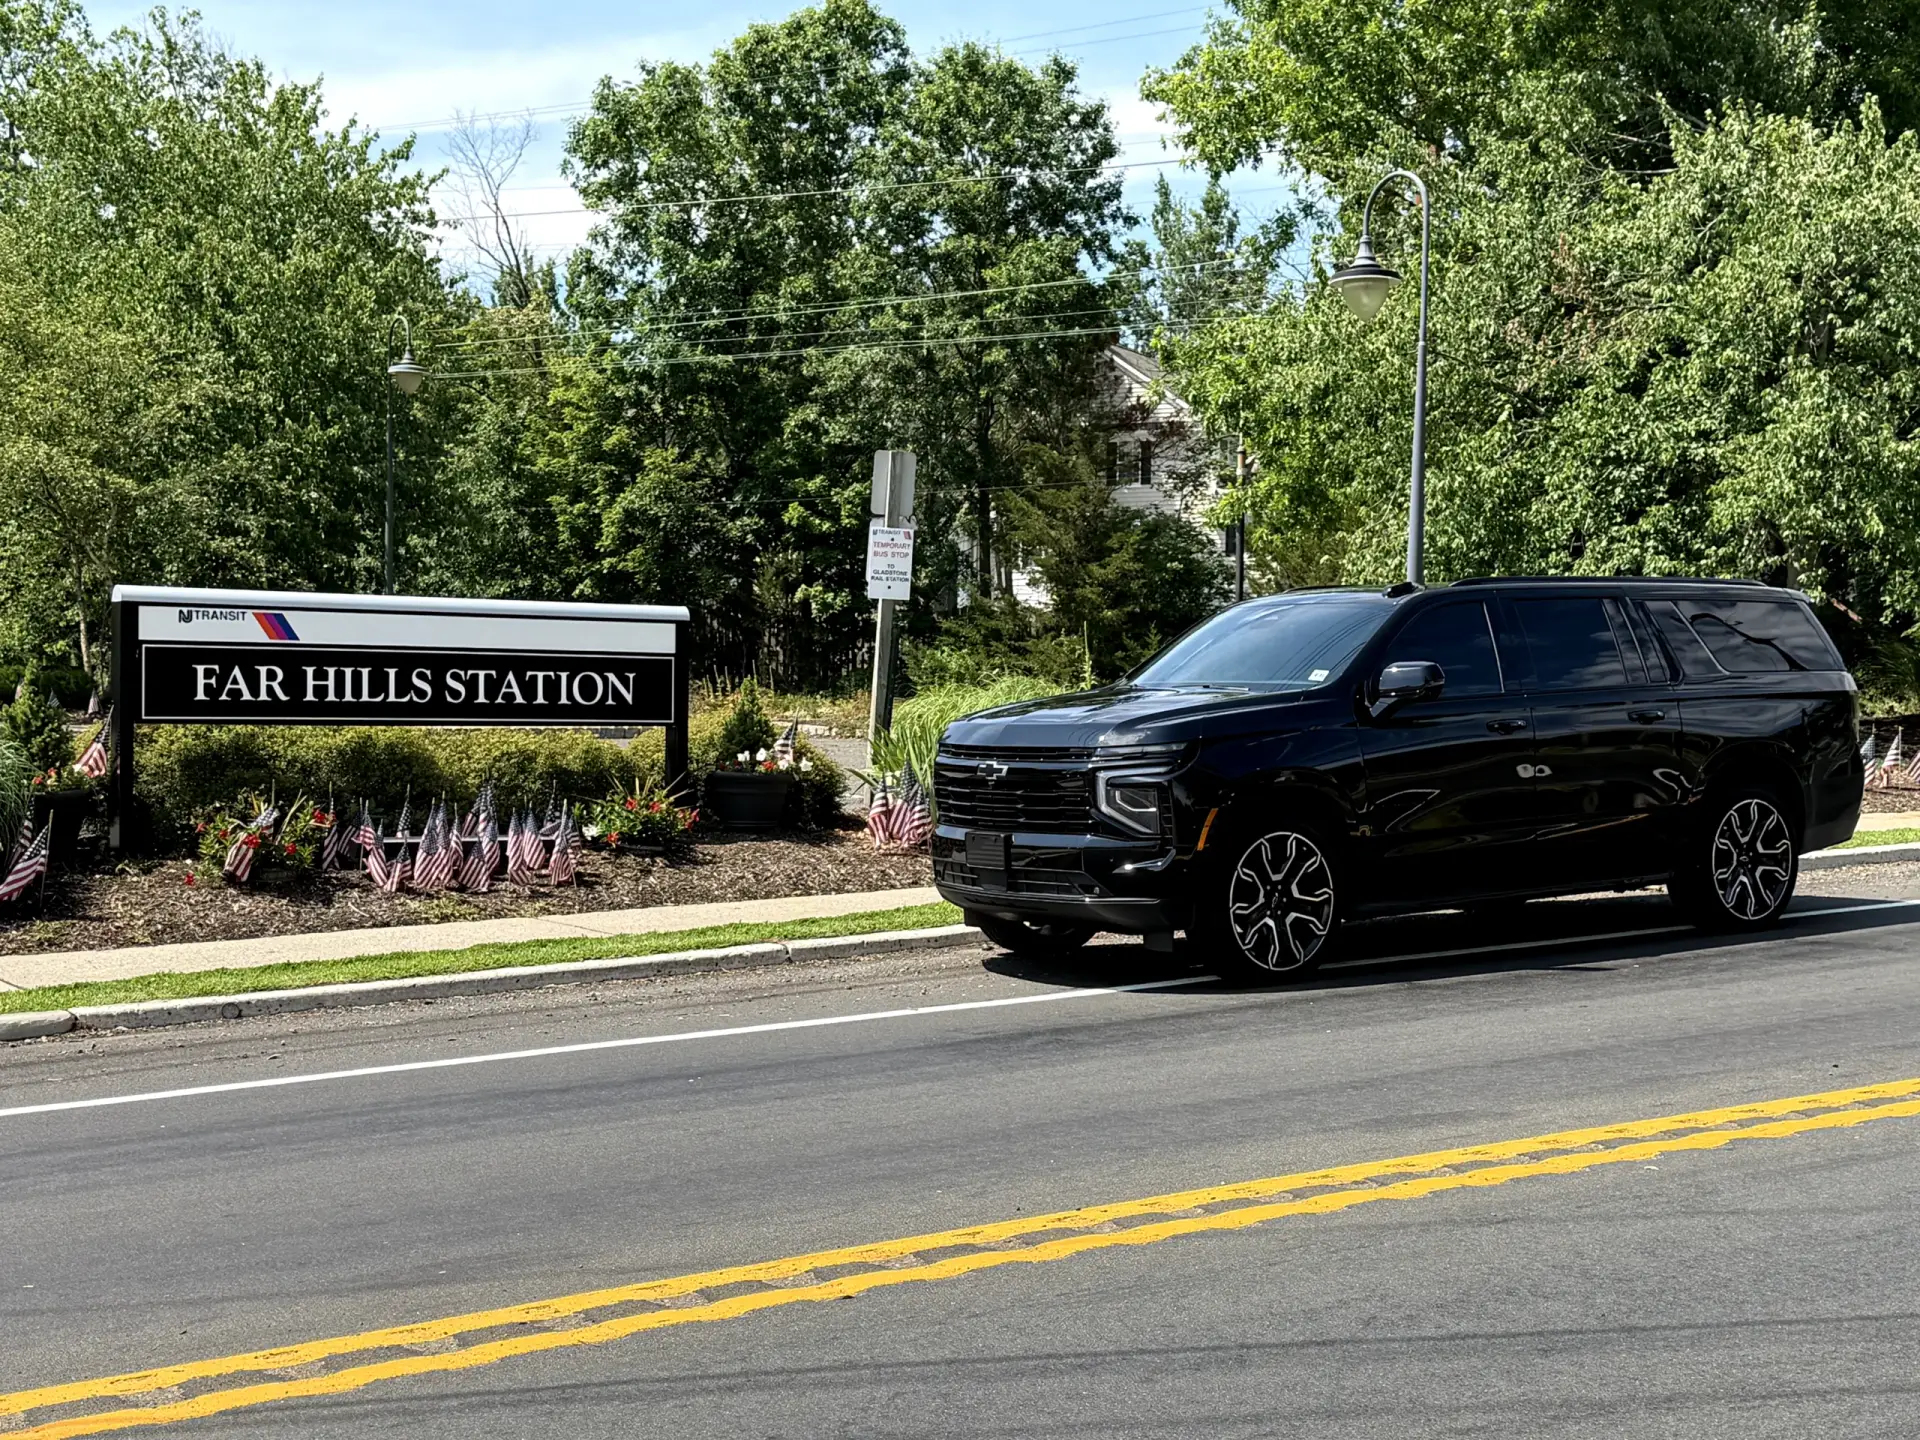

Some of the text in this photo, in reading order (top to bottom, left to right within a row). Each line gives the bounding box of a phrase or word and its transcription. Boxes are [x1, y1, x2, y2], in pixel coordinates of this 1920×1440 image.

[873, 541, 910, 549] TEMPORARY
[194, 609, 247, 621] TRANSIT
[192, 664, 637, 705] FAR HILLS STATION
